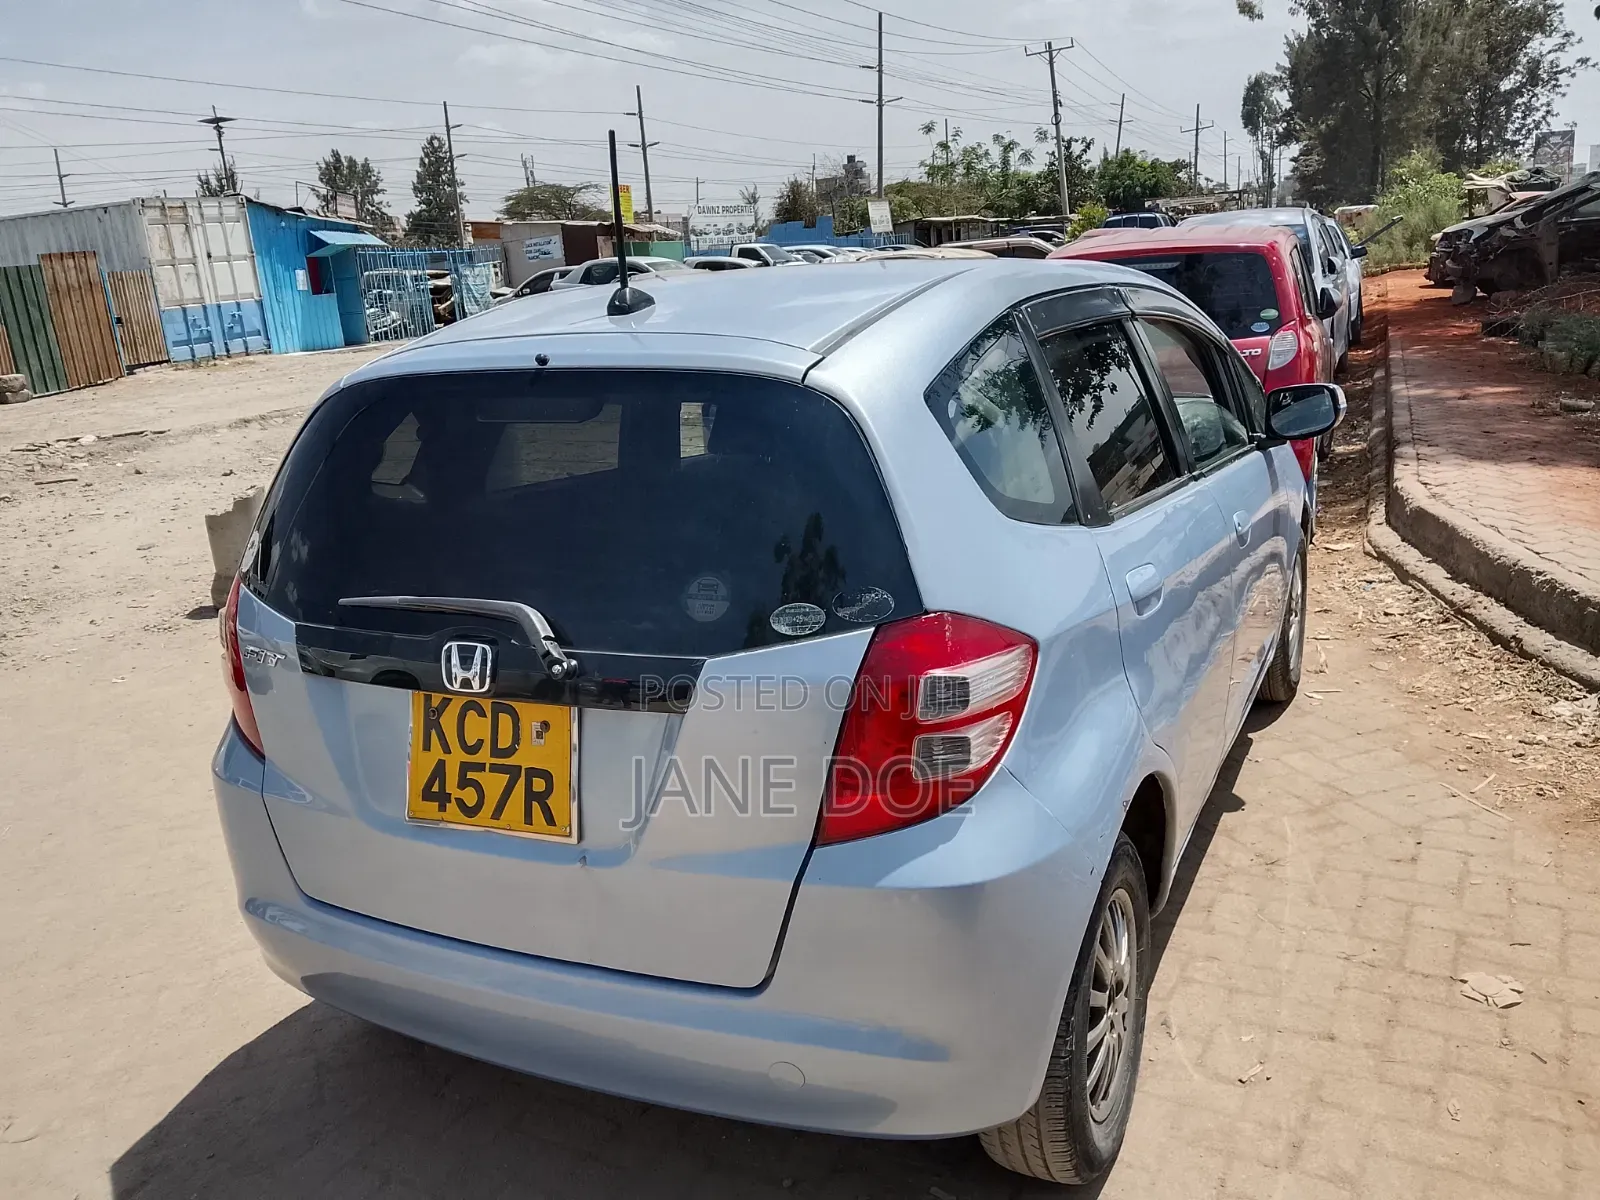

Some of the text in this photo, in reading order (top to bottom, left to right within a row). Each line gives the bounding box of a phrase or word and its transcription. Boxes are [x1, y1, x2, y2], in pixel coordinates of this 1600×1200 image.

[697, 205, 721, 214] DAWNZ
[422, 694, 521, 759] KCD
[421, 759, 557, 827] 457R
